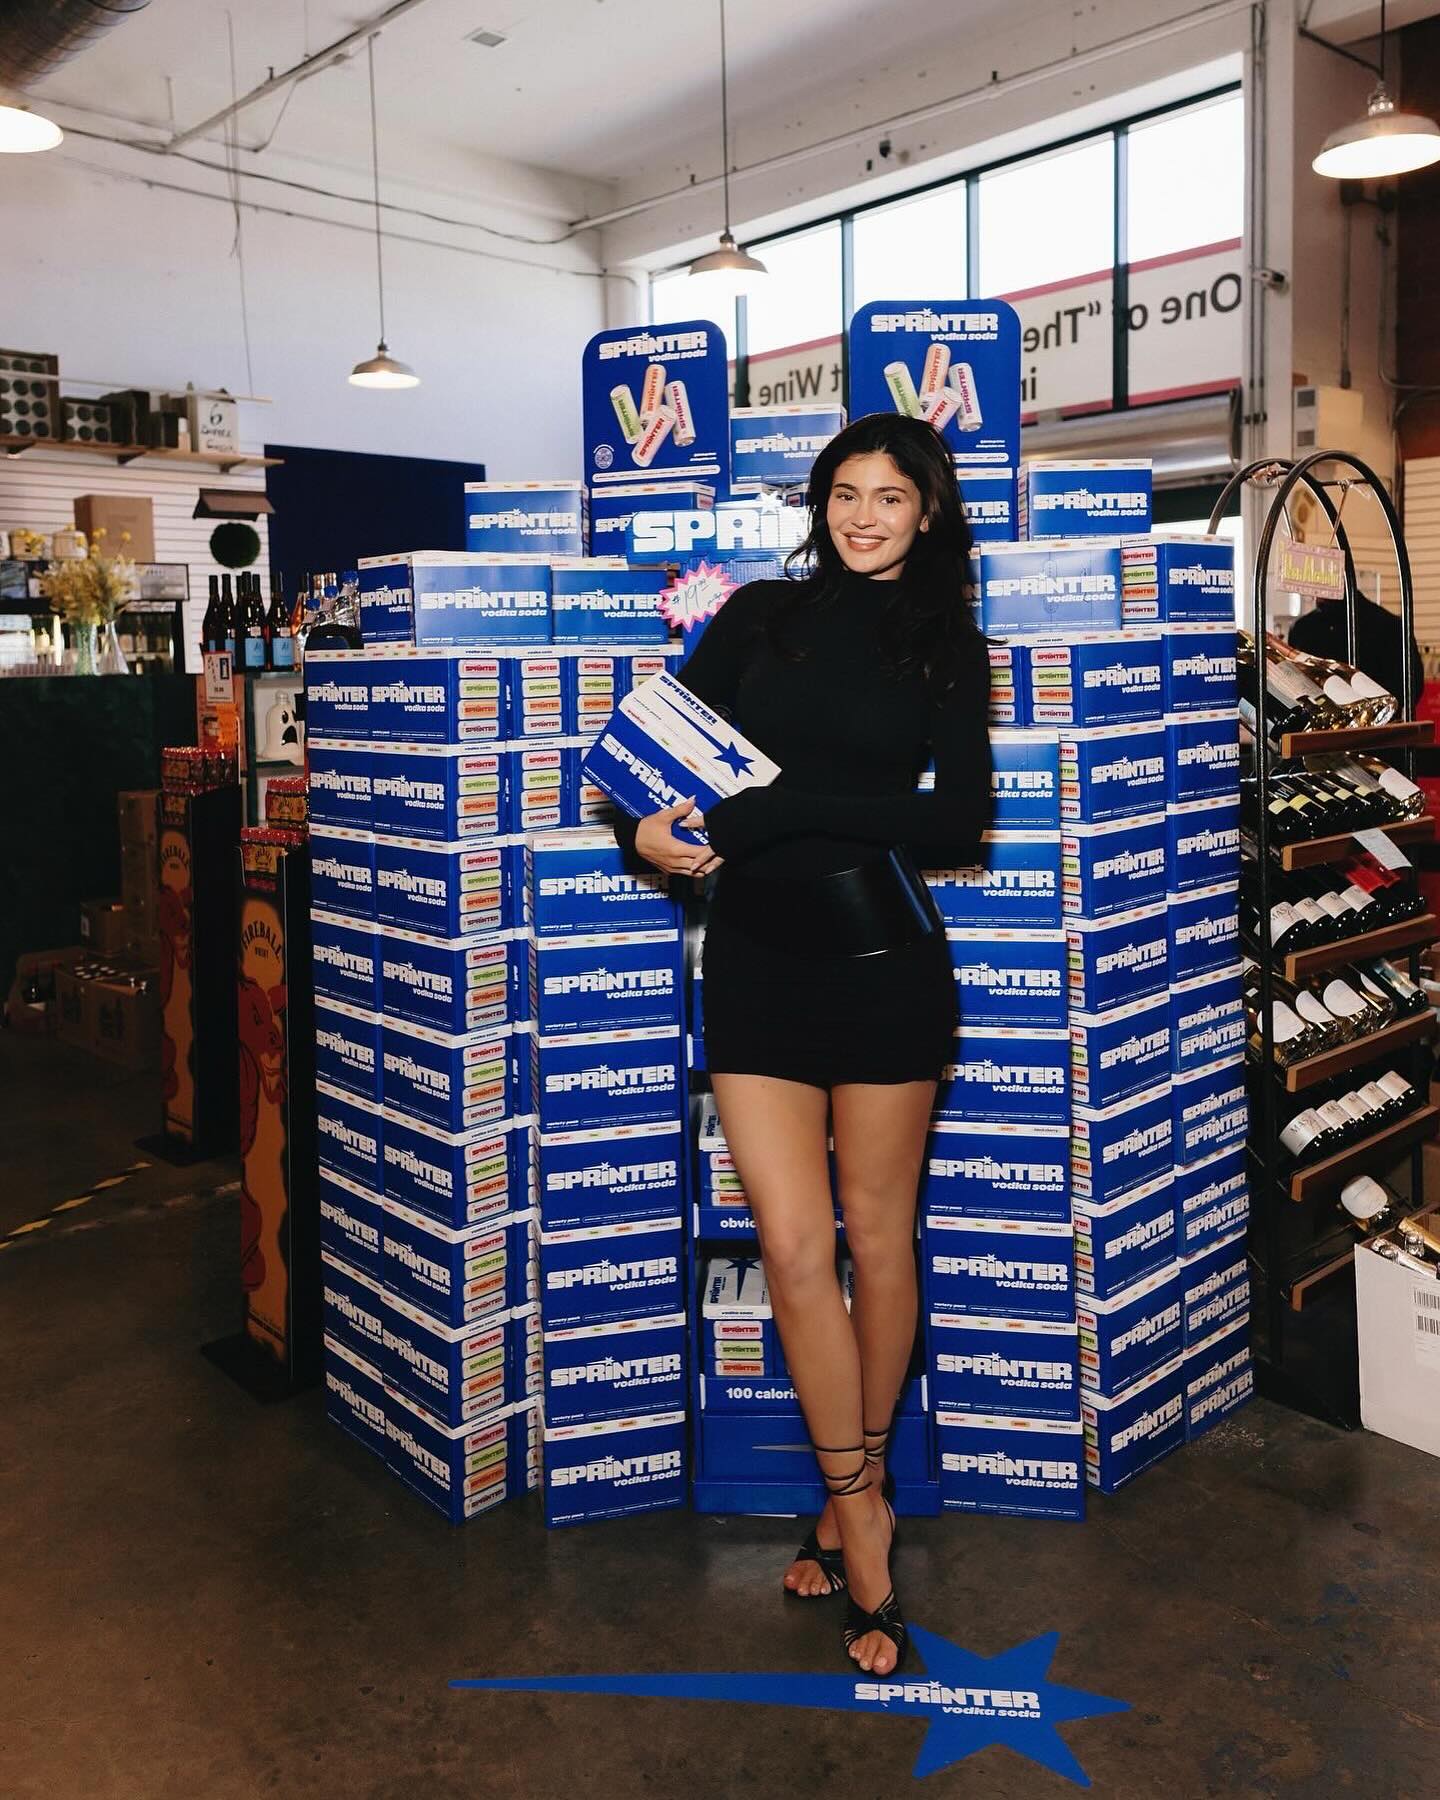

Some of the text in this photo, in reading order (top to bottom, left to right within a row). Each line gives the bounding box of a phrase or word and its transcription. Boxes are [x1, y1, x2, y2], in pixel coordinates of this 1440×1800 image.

[871, 308, 998, 333] SPRINTER
[599, 331, 708, 360] SPRINTER
[931, 332, 998, 341] vodka soda
[649, 349, 707, 362] vodka soda
[1033, 488, 1147, 511] SPRINTER
[1087, 508, 1147, 518] vodka soda
[469, 508, 577, 530] SPRINTER
[520, 526, 577, 536] vodka soda
[987, 572, 1117, 598] SPRINTER
[1169, 563, 1234, 585] SPRINTER
[420, 585, 549, 610] SPRINTER
[1047, 592, 1116, 603] vodka soda
[1201, 585, 1234, 594] vodka soda
[481, 608, 548, 618] vodka soda
[465, 664, 497, 673] SPRINTER
[1084, 662, 1161, 688] SPRINTER
[1173, 653, 1237, 677] SPRINTER
[307, 680, 369, 703] SPRINTER
[371, 680, 446, 703] SPRINTER
[659, 675, 718, 725] SPRINTER
[1121, 682, 1161, 693] vodka soda
[404, 703, 446, 713] vodka soda
[465, 725, 497, 734] SPRINTER
[1177, 741, 1240, 766] SPRINTER
[310, 768, 372, 794] SPRINTER
[1091, 756, 1165, 785] SPRINTER
[373, 774, 446, 801] SPRINTER
[1021, 790, 1053, 798] soda
[404, 799, 445, 810] vodka soda
[1177, 828, 1240, 856] SPRINTER
[312, 857, 373, 884] SPRINTER
[1093, 848, 1165, 880] SPRINTER
[377, 868, 447, 898] SPRINTER
[539, 871, 672, 896] SPRINTER
[602, 891, 669, 902] vodka soda
[407, 893, 447, 907] vodka soda
[242, 919, 282, 960] FIREBALL
[1175, 914, 1239, 946] SPRINTER
[313, 944, 374, 976] SPRINTER
[1096, 938, 1167, 975] SPRINTER
[383, 960, 453, 995] SPRINTER
[544, 967, 674, 995] SPRINTER
[606, 986, 673, 999] vodka soda
[988, 987, 1060, 996] vodka soda
[316, 1028, 375, 1065] SPRINTER
[470, 1046, 504, 1058] SPRINTER
[1100, 1028, 1170, 1069] SPRINTER
[1180, 1020, 1246, 1057] SPRINTER
[383, 1052, 450, 1092] SPRINTER
[546, 1064, 676, 1092] SPRINTER
[608, 1082, 675, 1096] vodka soda
[992, 1084, 1064, 1094] vodka soda
[317, 1114, 378, 1156] SPRINTER
[1103, 1119, 1172, 1164] SPRINTER
[1185, 1107, 1248, 1149] SPRINTER
[384, 1144, 453, 1190] SPRINTER
[547, 1161, 677, 1191] SPRINTER
[928, 1155, 1065, 1183] SPRINTER
[609, 1179, 677, 1194] vodka soda
[992, 1181, 1064, 1192] vodka soda
[320, 1200, 379, 1243] SPRINTER
[1186, 1195, 1250, 1240] SPRINTER
[1105, 1209, 1175, 1260] SPRINTER
[383, 1235, 451, 1287] SPRINTER
[547, 1257, 677, 1290] SPRINTER
[932, 1254, 1070, 1281] SPRINTER
[609, 1275, 677, 1291] vodka soda
[996, 1279, 1068, 1291] vodka soda
[324, 1285, 383, 1333] SPRINTER
[1188, 1281, 1250, 1332] SPRINTER
[1111, 1302, 1181, 1357] SPRINTER
[383, 1328, 450, 1386] SPRINTER
[550, 1354, 681, 1387] SPRINTER
[936, 1352, 1073, 1380] SPRINTER
[613, 1372, 681, 1389] vodka soda
[726, 1387, 752, 1399] 100
[1000, 1378, 1073, 1390] vodka soda
[326, 1371, 386, 1428] SPRINTER
[1190, 1370, 1253, 1425] SPRINTER
[1111, 1394, 1183, 1454] SPRINTER
[385, 1417, 451, 1483] SPRINTER
[551, 1450, 682, 1487] SPRINTER
[613, 1469, 681, 1487] vodka soda
[942, 1451, 1079, 1480] SPRINTER
[1005, 1477, 1078, 1489] vodka soda
[855, 1680, 1041, 1709] SPRINTER
[942, 1706, 1041, 1718] vodka soda
